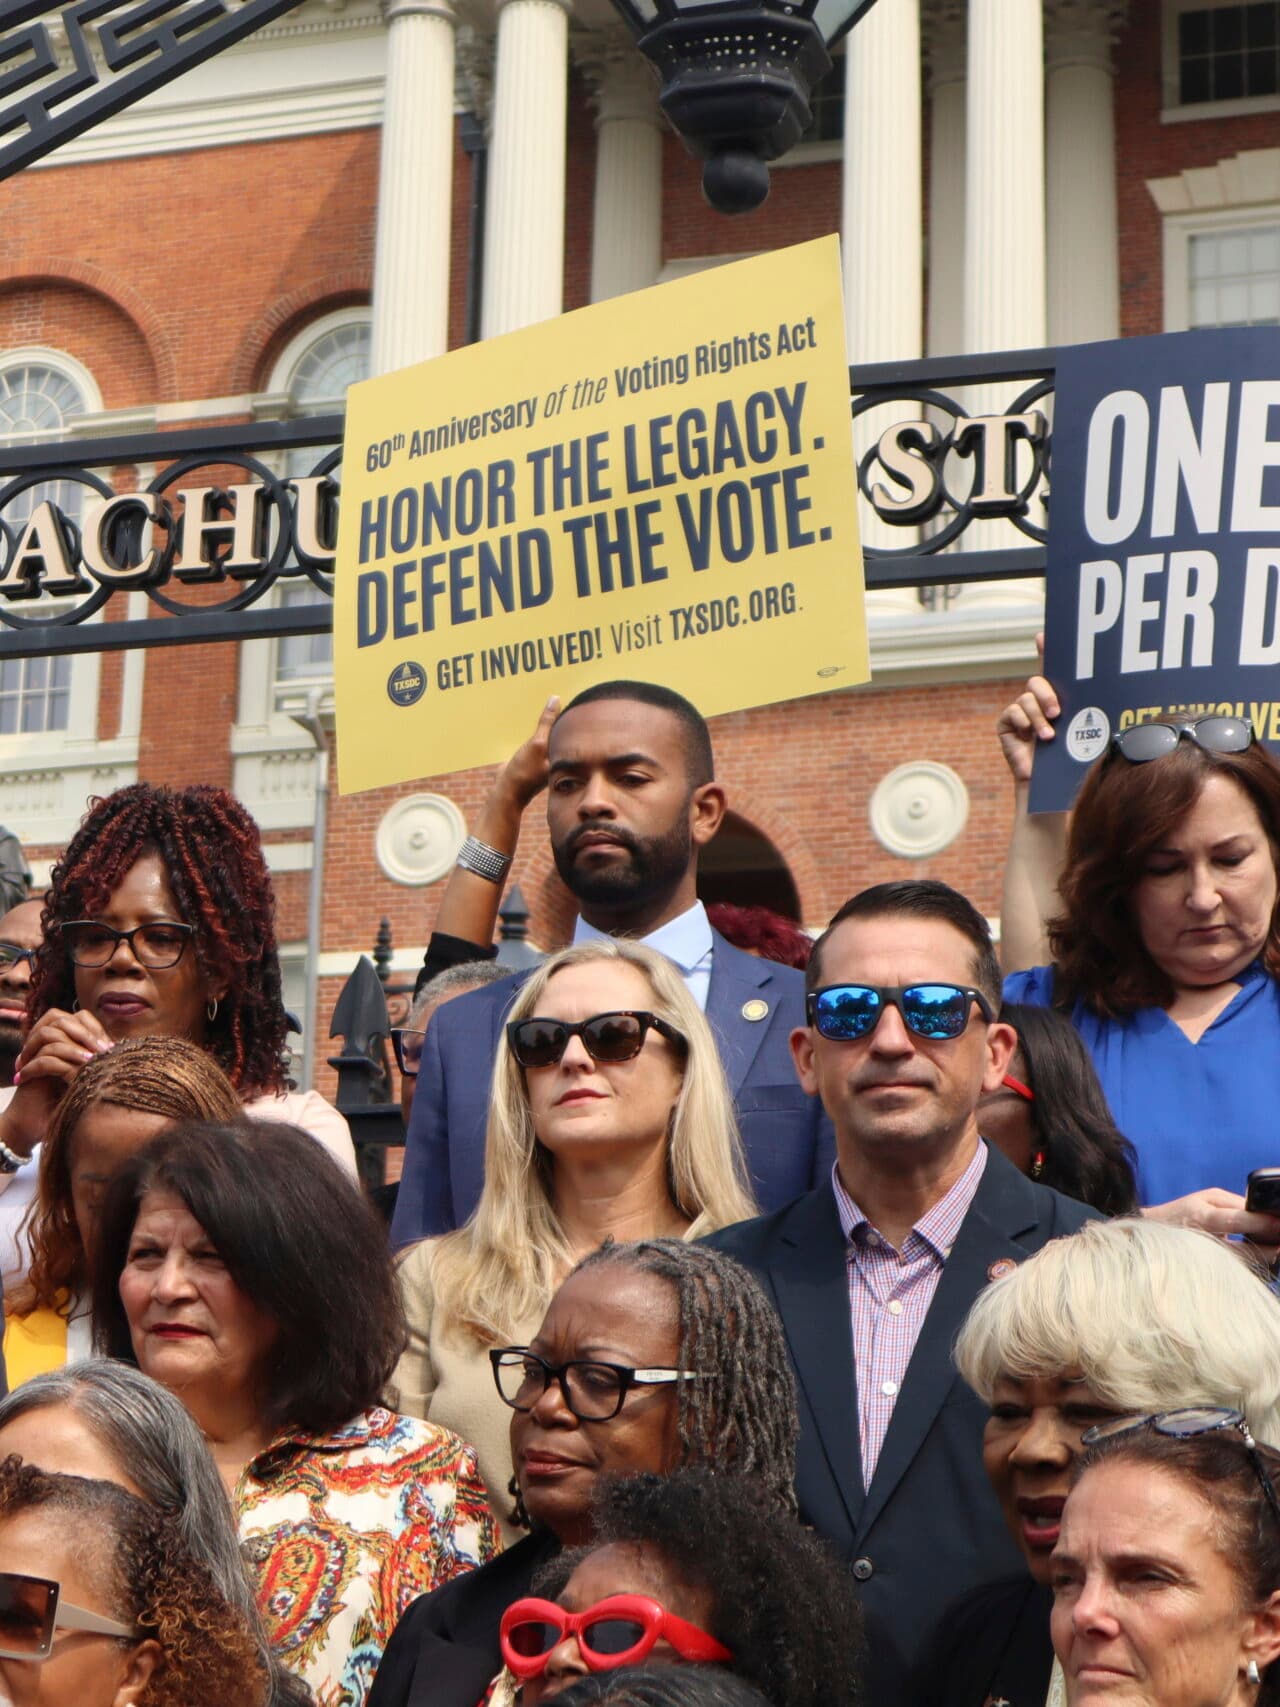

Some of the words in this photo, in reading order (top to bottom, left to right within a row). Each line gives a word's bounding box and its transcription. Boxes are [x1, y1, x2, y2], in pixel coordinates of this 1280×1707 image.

[366, 433, 405, 472] 60th
[409, 397, 538, 459] Anniversary
[544, 384, 569, 418] of
[572, 376, 608, 410] the
[615, 352, 689, 397] Voting
[695, 332, 771, 376] Rights
[777, 317, 817, 355] Act
[1084, 380, 1280, 545] ONE
[359, 459, 516, 564] HONOR
[527, 431, 612, 517] THE
[624, 381, 824, 494] LEGACY.
[357, 528, 553, 648] DEFEND
[563, 499, 668, 598] THE
[676, 464, 832, 572] VOTE.
[1076, 549, 1219, 680] PER
[394, 677, 420, 691] TXSDC
[437, 653, 474, 690] GET
[482, 627, 602, 681] INVOLVED!
[611, 614, 662, 654] Visit
[669, 582, 804, 640] TXSDC.ORG.
